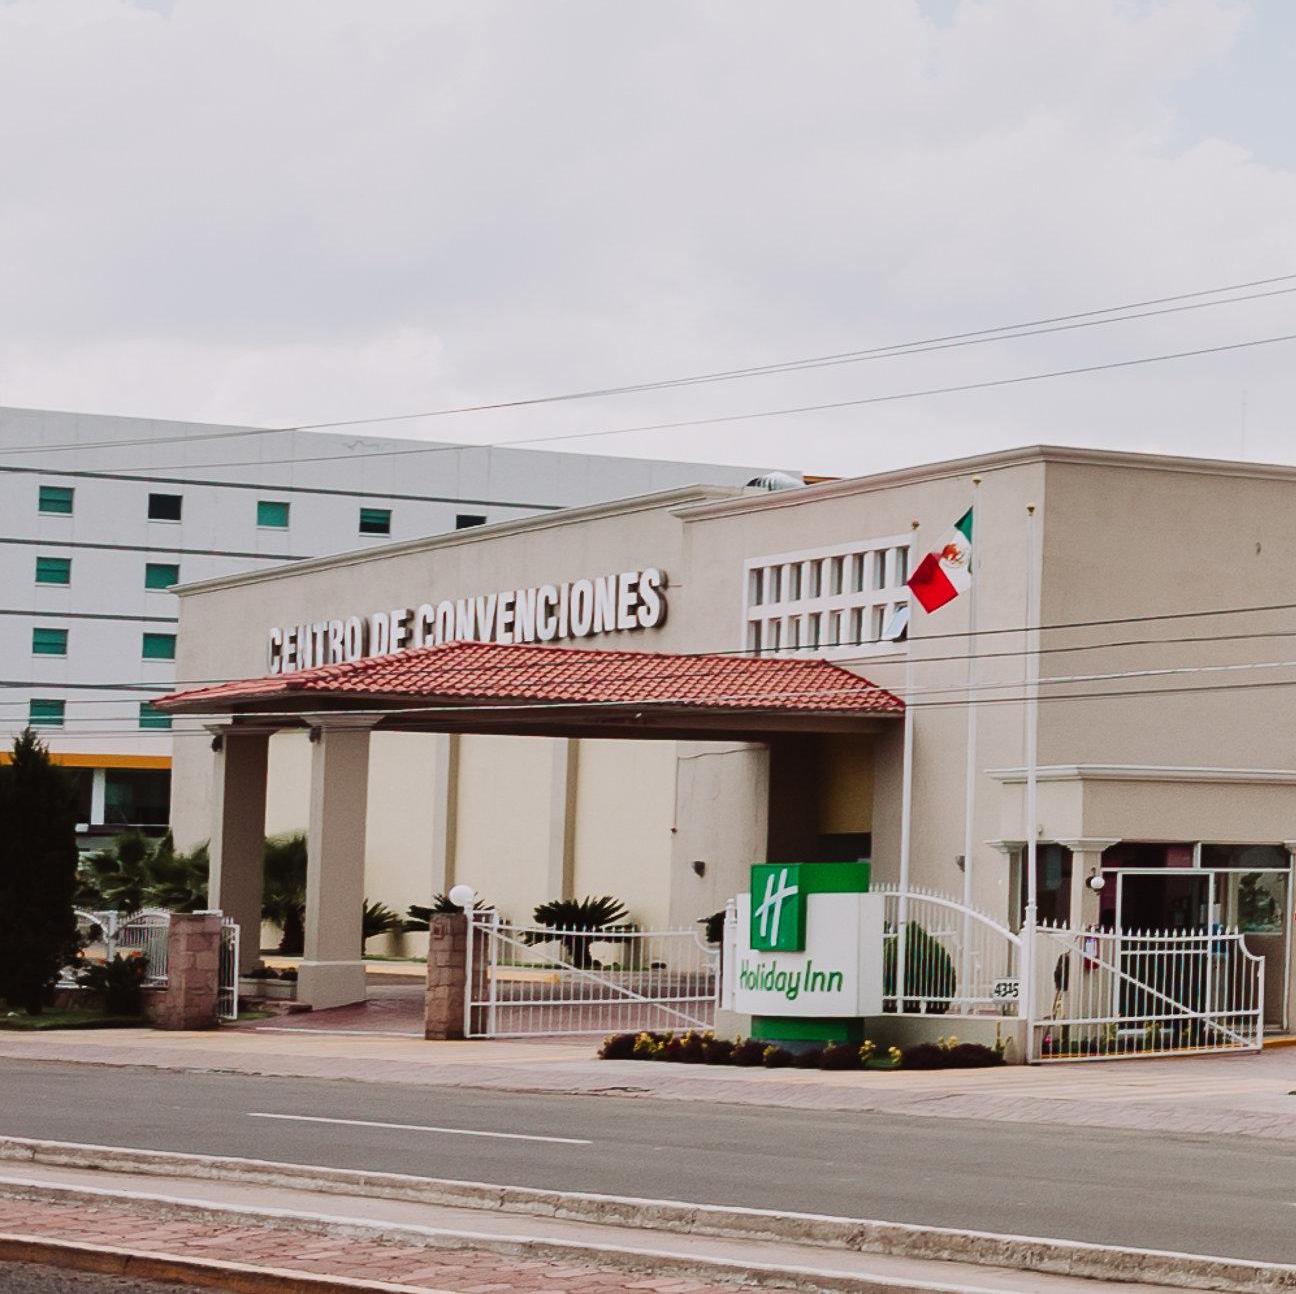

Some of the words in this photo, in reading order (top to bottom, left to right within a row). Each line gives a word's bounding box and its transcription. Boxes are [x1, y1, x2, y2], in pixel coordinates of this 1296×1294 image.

[267, 614, 365, 675] CENTRO
[368, 608, 411, 658] DE
[414, 566, 666, 650] CONVENCIONES
[739, 959, 801, 1001] Holiday
[803, 959, 844, 993] Inn
